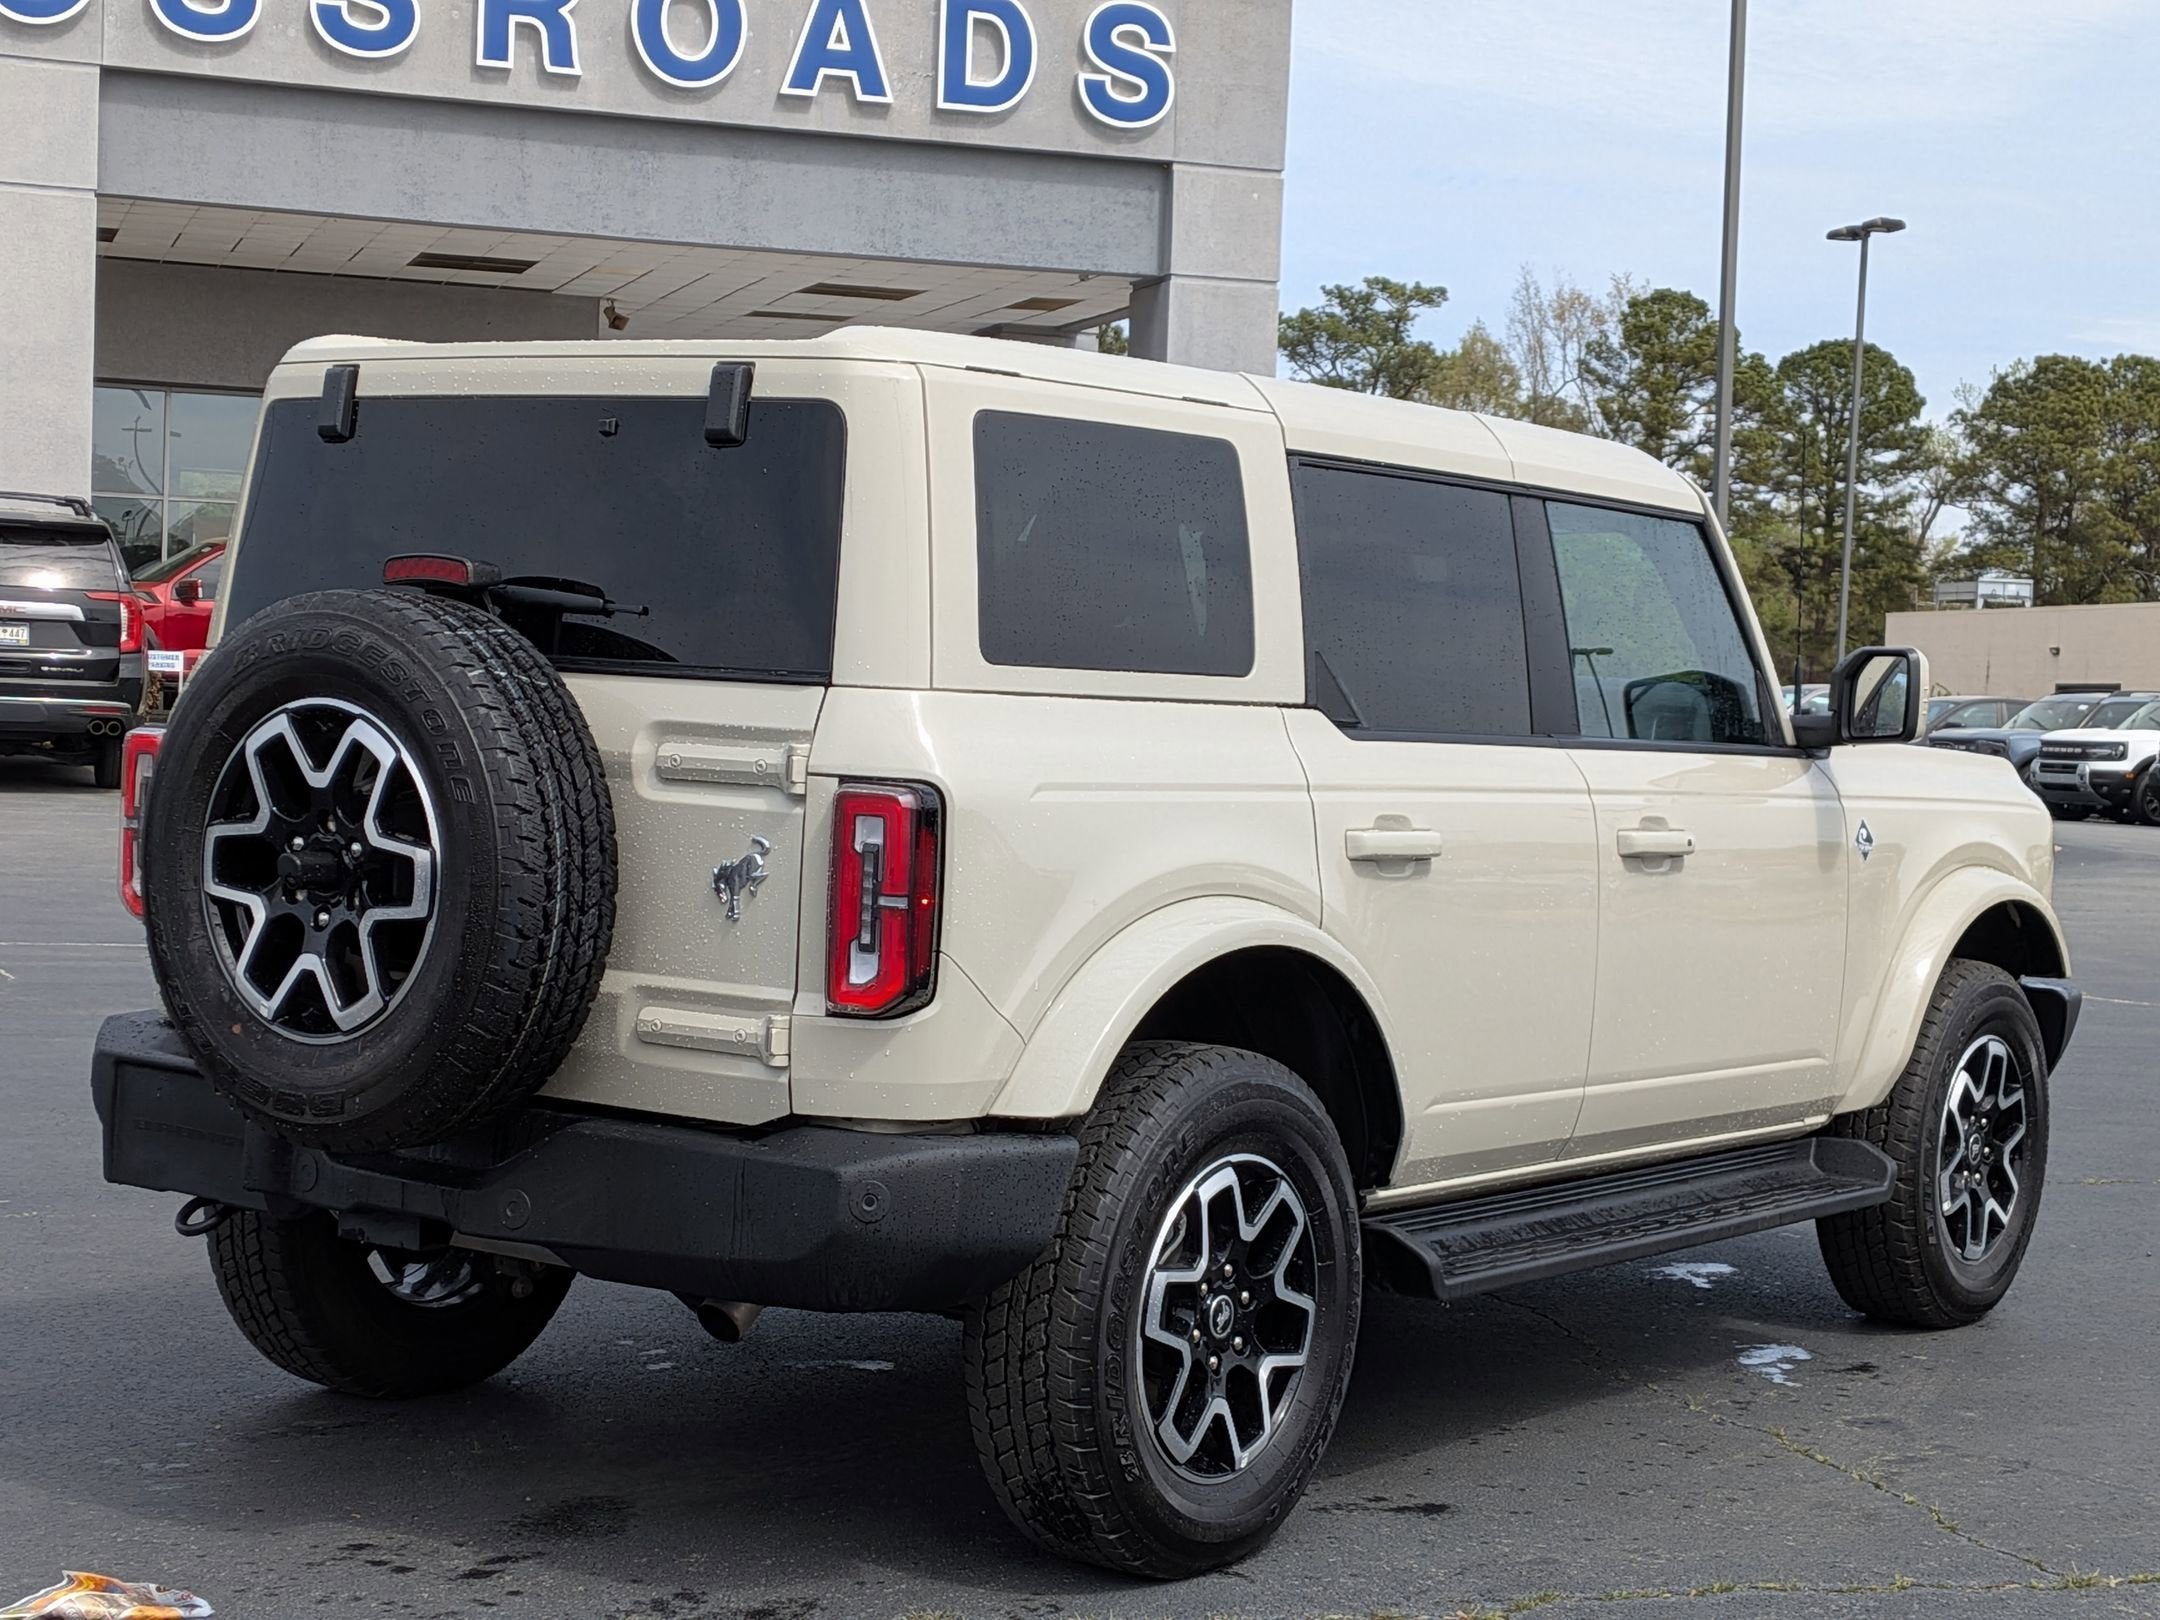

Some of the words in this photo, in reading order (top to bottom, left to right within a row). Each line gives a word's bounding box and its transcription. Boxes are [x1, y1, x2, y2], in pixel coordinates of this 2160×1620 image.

[0, 0, 1177, 129] ROADS
[0, 605, 26, 615] MC
[232, 625, 477, 805] BRIDGESTONE
[1103, 1119, 1200, 1484] BRIDGESTONE
